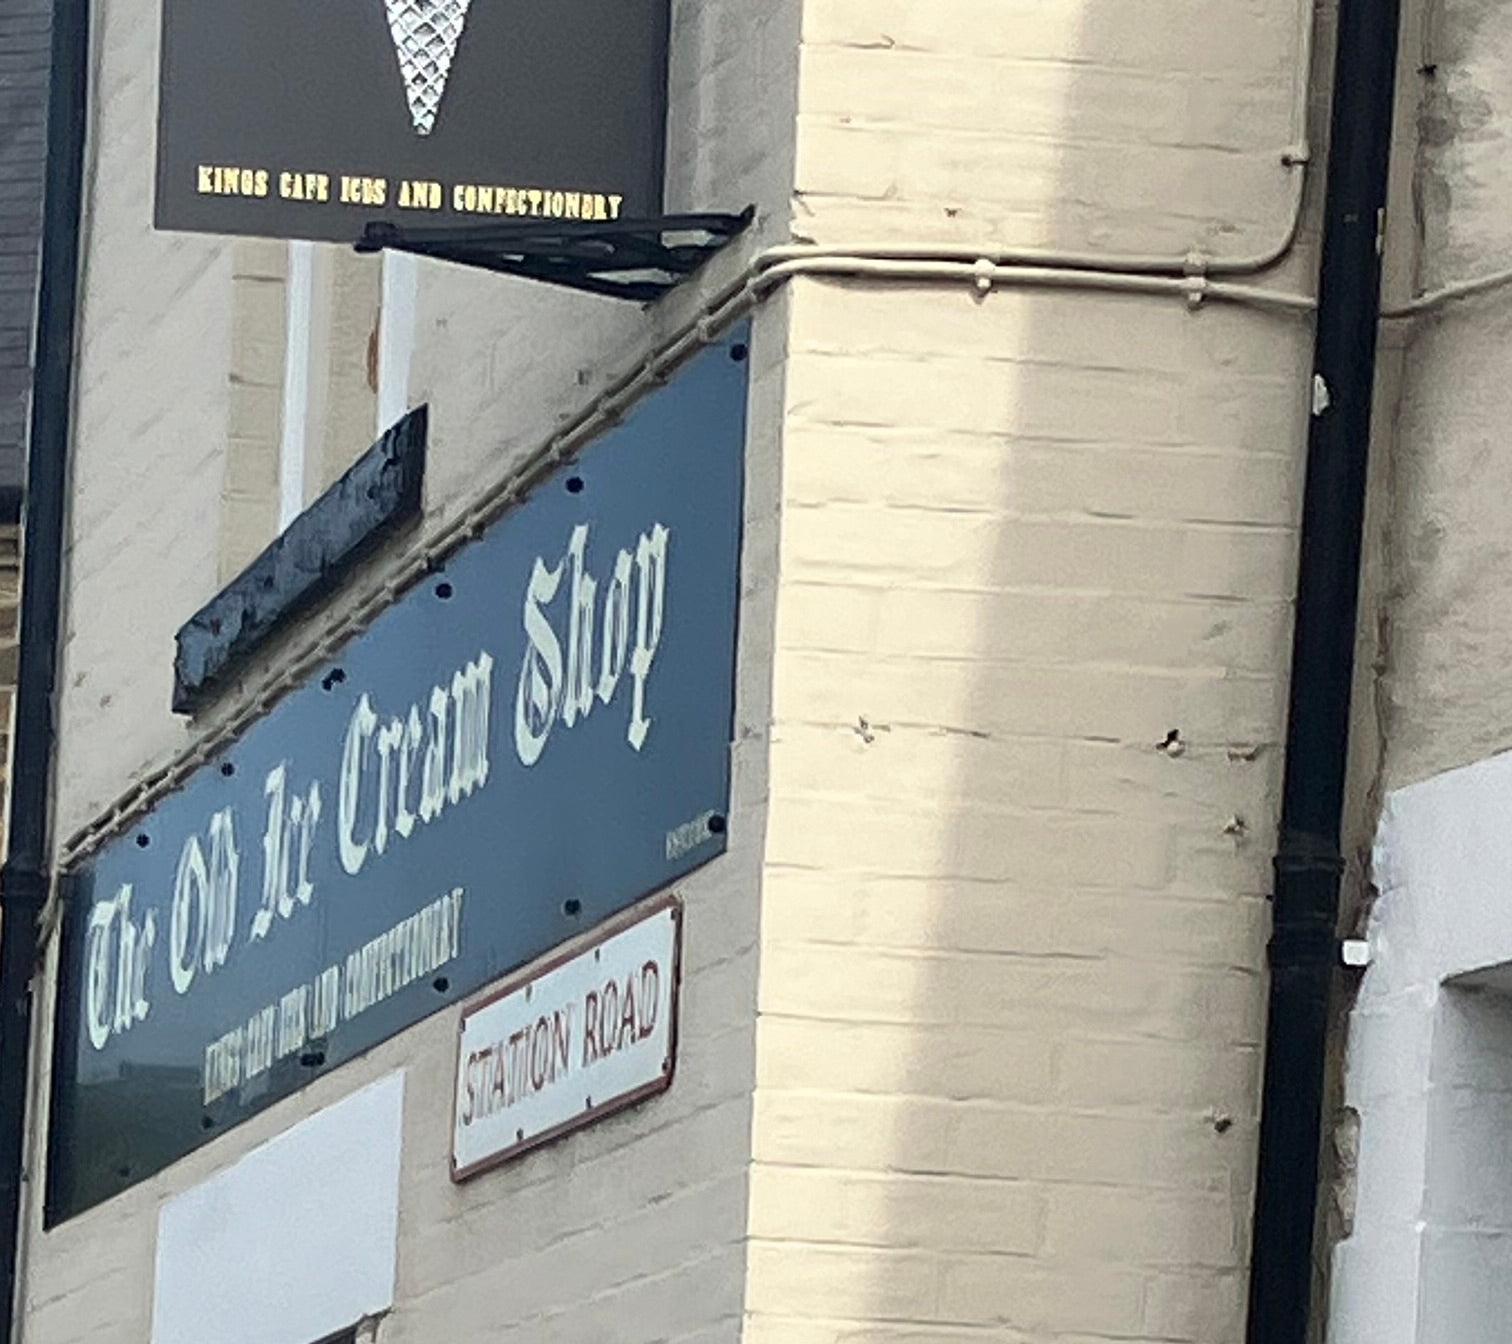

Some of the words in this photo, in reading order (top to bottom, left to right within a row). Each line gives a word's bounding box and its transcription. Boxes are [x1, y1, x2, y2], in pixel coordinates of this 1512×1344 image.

[197, 164, 268, 198] KINGS
[279, 172, 329, 203] CAFE
[340, 175, 386, 206] ICES
[398, 180, 443, 210] AND
[452, 185, 624, 221] CONFECTIONERY
[86, 882, 158, 1051] The
[168, 804, 239, 995] Old
[247, 758, 324, 943] Ice
[336, 648, 494, 876] Cream
[513, 521, 670, 769] Shop
[463, 1003, 572, 1127] STATION
[581, 959, 660, 1069] ROAD
